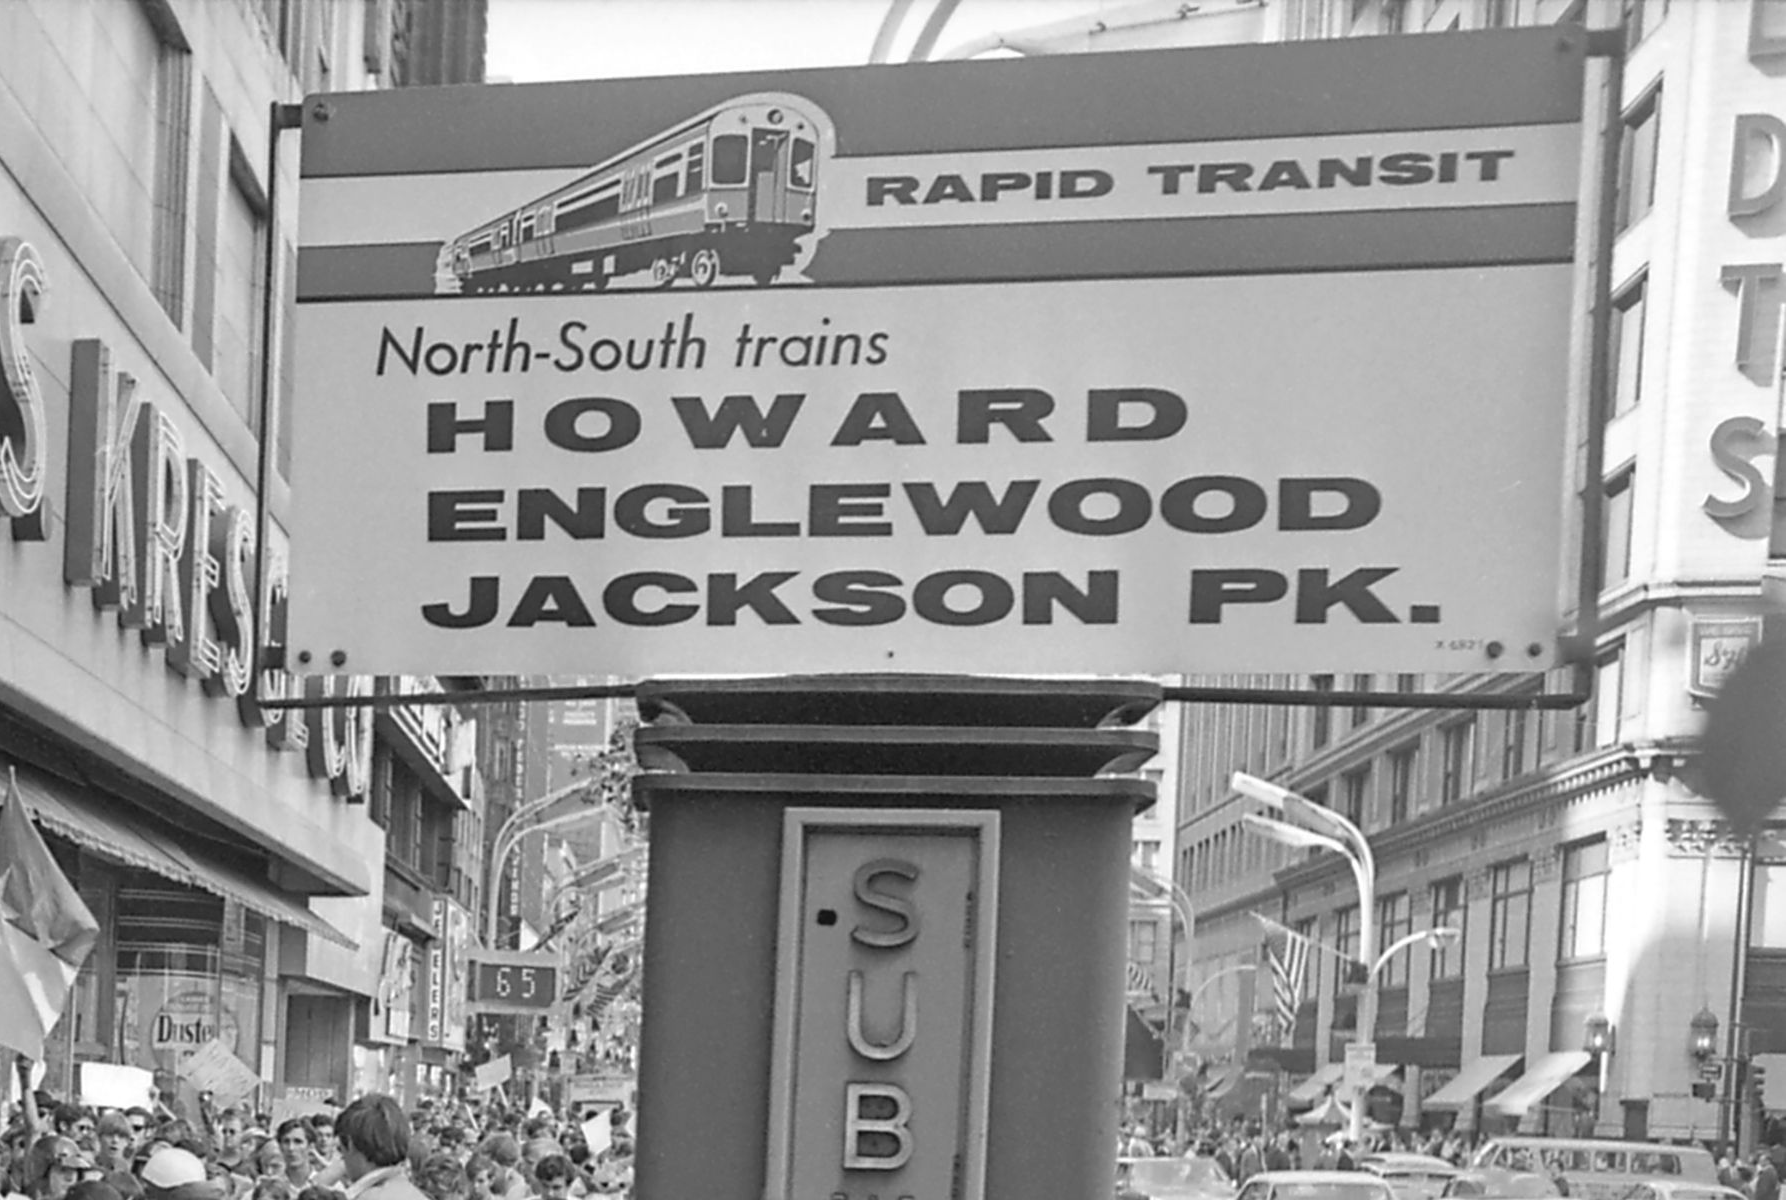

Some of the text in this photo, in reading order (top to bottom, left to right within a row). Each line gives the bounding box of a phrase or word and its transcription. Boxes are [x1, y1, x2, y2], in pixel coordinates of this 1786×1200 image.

[866, 150, 1515, 205] RAPID TRANSIT
[376, 312, 889, 376] North-South trains
[427, 387, 1189, 454] HOWARD
[427, 475, 1382, 542] ENGLEWOOD
[421, 567, 1441, 629] JACKSON PK.
[496, 967, 536, 998] 65
